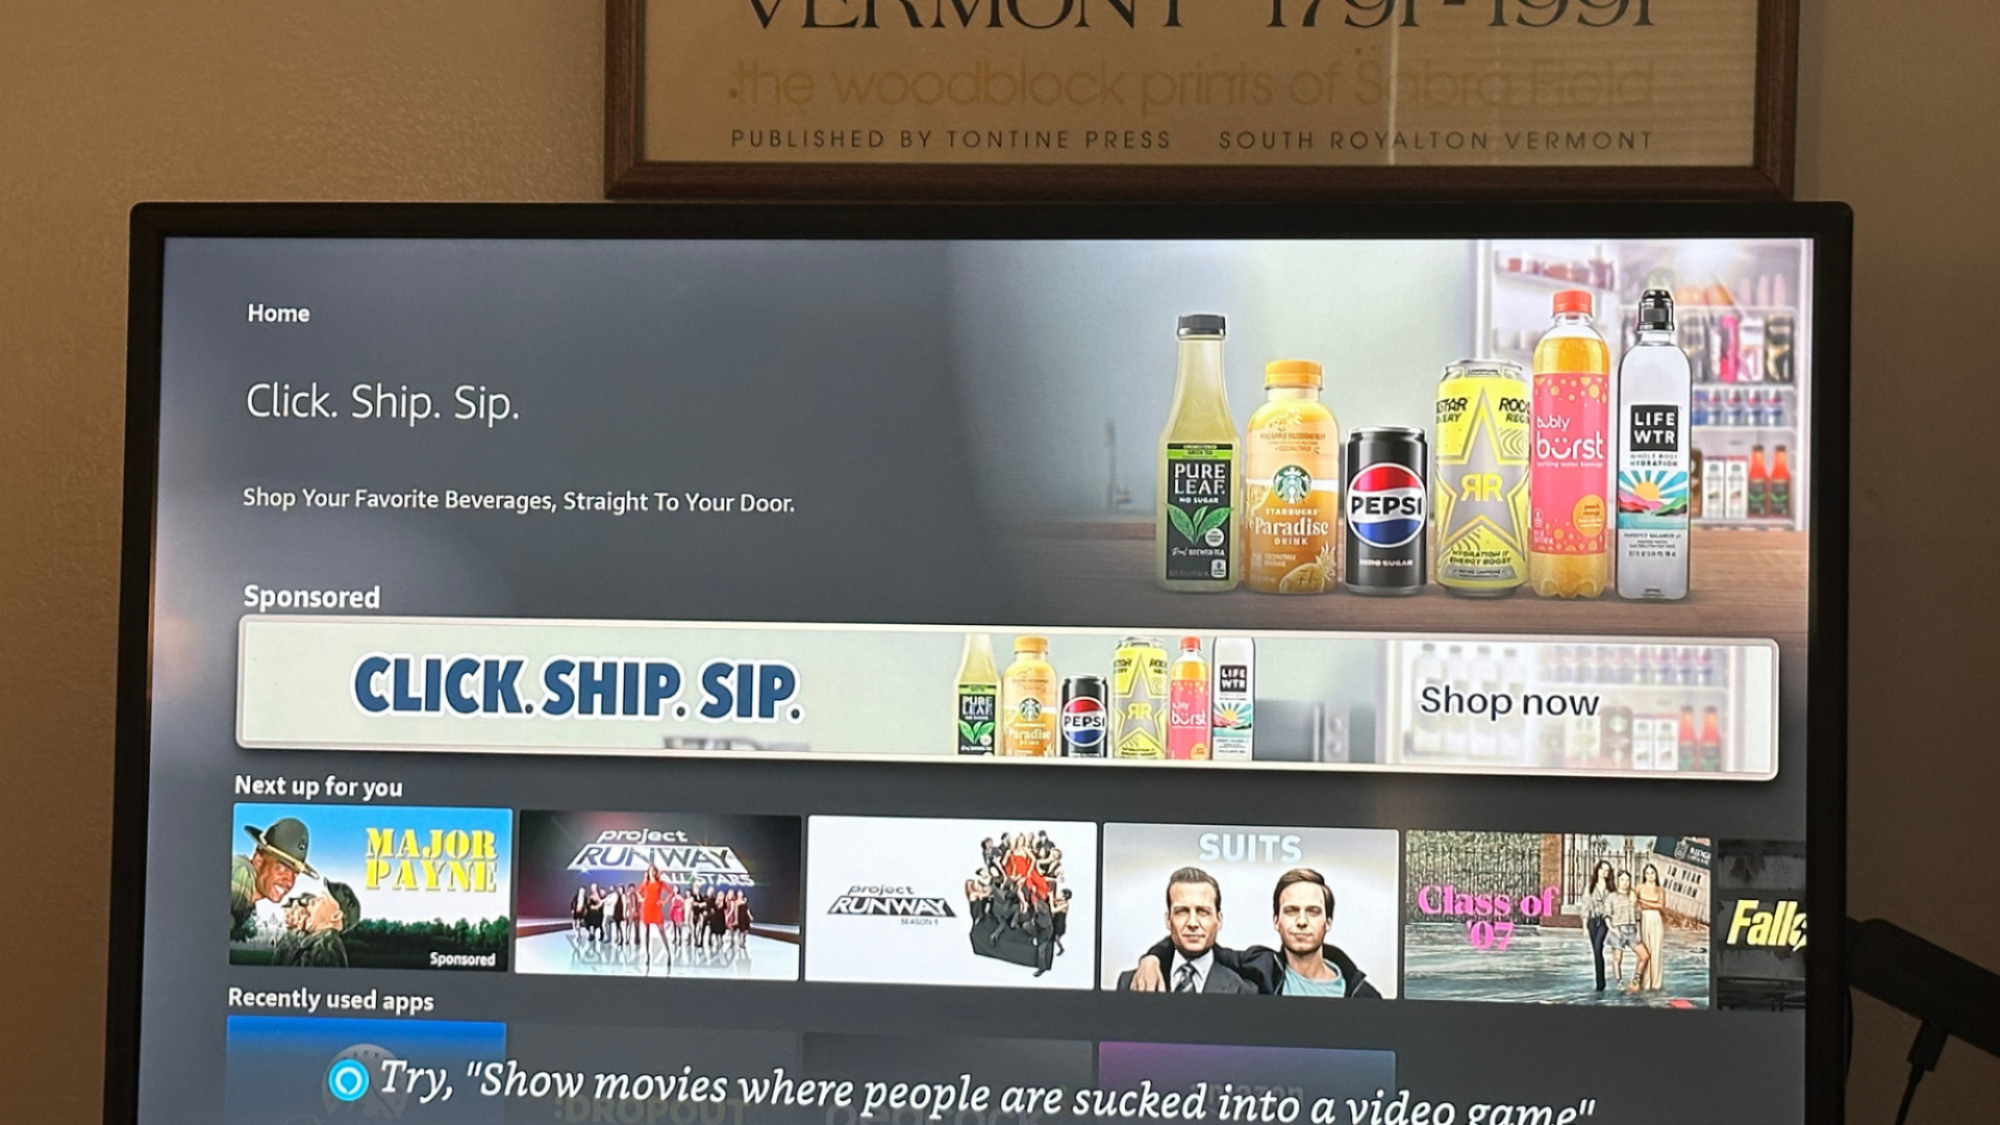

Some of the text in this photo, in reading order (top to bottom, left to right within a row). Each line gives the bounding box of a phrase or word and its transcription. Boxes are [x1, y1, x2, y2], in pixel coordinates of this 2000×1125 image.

[736, 61, 815, 104] the
[834, 60, 1125, 105] woodblock
[1140, 61, 1274, 116] prints
[1289, 60, 1342, 104] of
[731, 129, 1654, 150] PUBLISHED BY TONTINE PRESS SOUTH ROYALTON VERMONT
[247, 303, 311, 324] Home
[247, 382, 520, 428] Click. Ship. Sip.
[1536, 414, 1571, 432] bubly
[1634, 411, 1675, 427] LIFE
[1633, 429, 1675, 445] WTR
[1174, 463, 1226, 479] PURE
[243, 487, 796, 516] Shop Your Favorite Beverages, Straight To Your Door.
[1265, 508, 1319, 516] STARBUCKS
[1351, 496, 1422, 516] PEPSI
[1255, 516, 1329, 536] Paradise
[1273, 537, 1308, 546] DRINK
[243, 583, 381, 613] Sponsored
[1221, 668, 1247, 679] LIFE
[354, 656, 802, 720] CLICK. SHIP. SIP.
[1221, 680, 1247, 690] WTR
[1420, 684, 1600, 722] Shop now
[1064, 715, 1105, 727] PEPSI
[235, 776, 403, 803] Next up for you
[365, 828, 497, 861] MAJOR
[596, 828, 689, 845] project
[576, 846, 732, 868] RUNWAY
[1198, 832, 1303, 864] SUITS
[365, 860, 497, 892] PAYNE
[692, 874, 756, 887] STARS
[847, 884, 915, 896] project
[831, 897, 948, 916] RUNWAY
[1417, 885, 1562, 918] Class of
[1467, 921, 1514, 951] '07
[429, 951, 496, 968] Sponsored
[228, 987, 435, 1015] Recently used apps
[380, 1060, 454, 1104] Try,
[466, 1060, 585, 1099] "Show
[596, 1066, 728, 1103] movies
[738, 1068, 854, 1105] where
[862, 1074, 991, 1120] people
[1000, 1084, 1063, 1114] are
[1072, 1081, 1206, 1120] sucked
[1218, 1084, 1301, 1122] into
[1310, 1096, 1335, 1124] a
[1345, 1090, 1456, 1125] video
